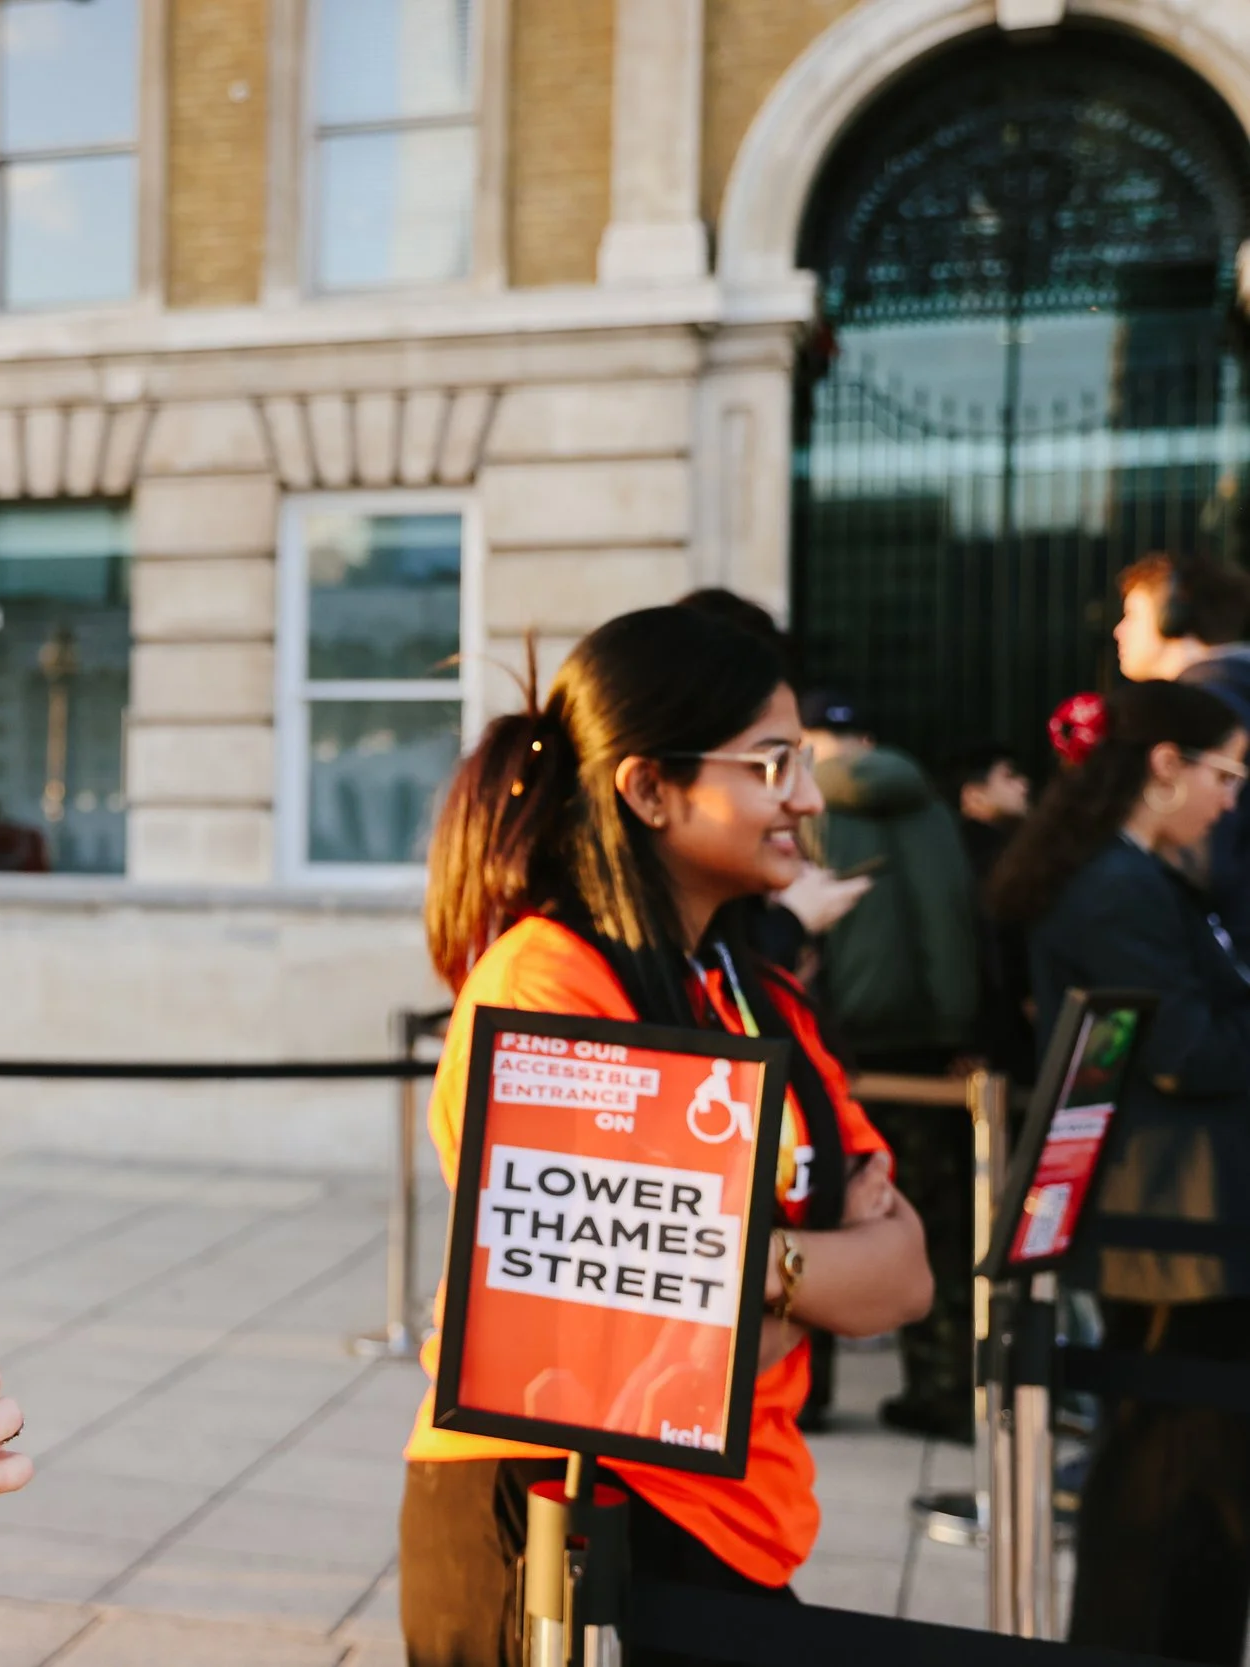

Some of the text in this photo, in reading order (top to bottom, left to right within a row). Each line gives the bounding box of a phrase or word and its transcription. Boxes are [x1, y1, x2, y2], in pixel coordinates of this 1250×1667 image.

[502, 1032, 628, 1063] FIND OUR
[501, 1058, 653, 1089] ACCESSIBLE
[501, 1082, 629, 1105] ENTRANCE
[595, 1112, 635, 1133] ON
[505, 1162, 702, 1216] LOWER
[492, 1206, 726, 1258] THAMES
[501, 1248, 724, 1308] STREET
